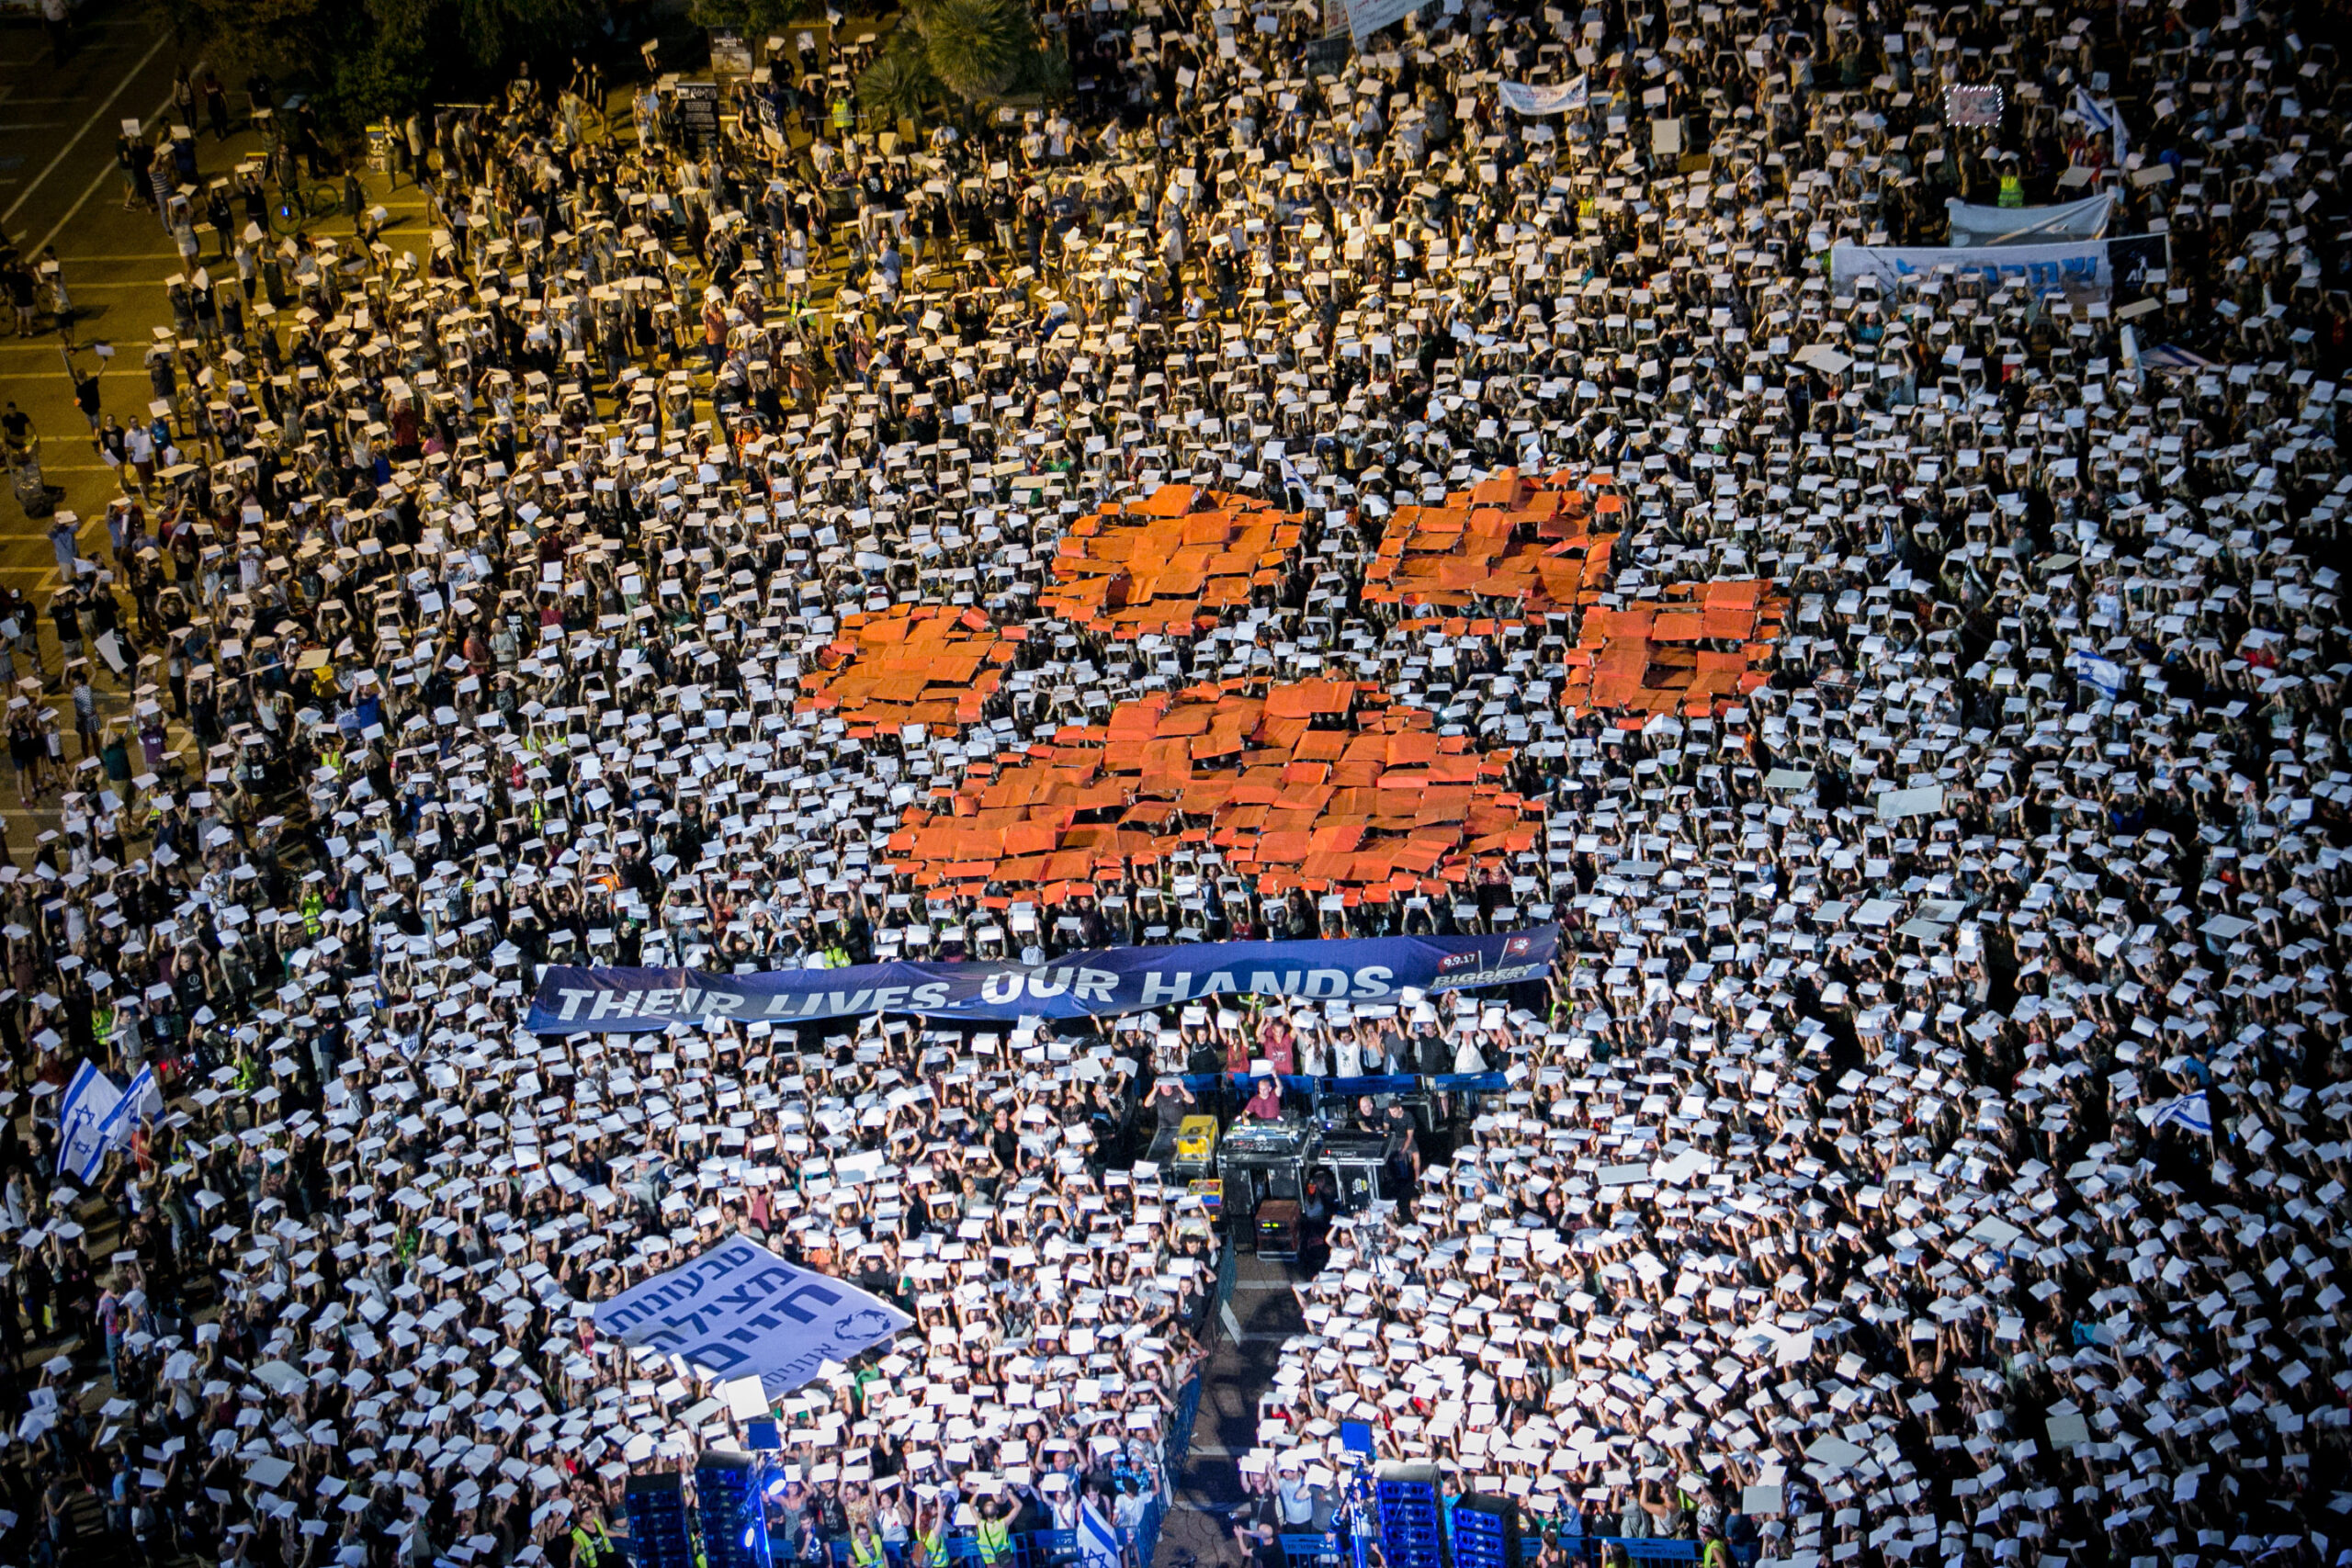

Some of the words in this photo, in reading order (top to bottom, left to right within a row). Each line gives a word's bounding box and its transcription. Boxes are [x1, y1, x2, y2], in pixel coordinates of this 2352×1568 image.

[558, 987, 745, 1021] THEIR
[763, 982, 961, 1016] LIVES.
[980, 965, 1120, 1005] OUR
[1442, 953, 1476, 968] 9.9.17
[603, 1246, 755, 1333] טבעונות
[639, 1267, 798, 1353] מצילה
[682, 1284, 842, 1372] חיים
[762, 1342, 840, 1387] אנונימו
